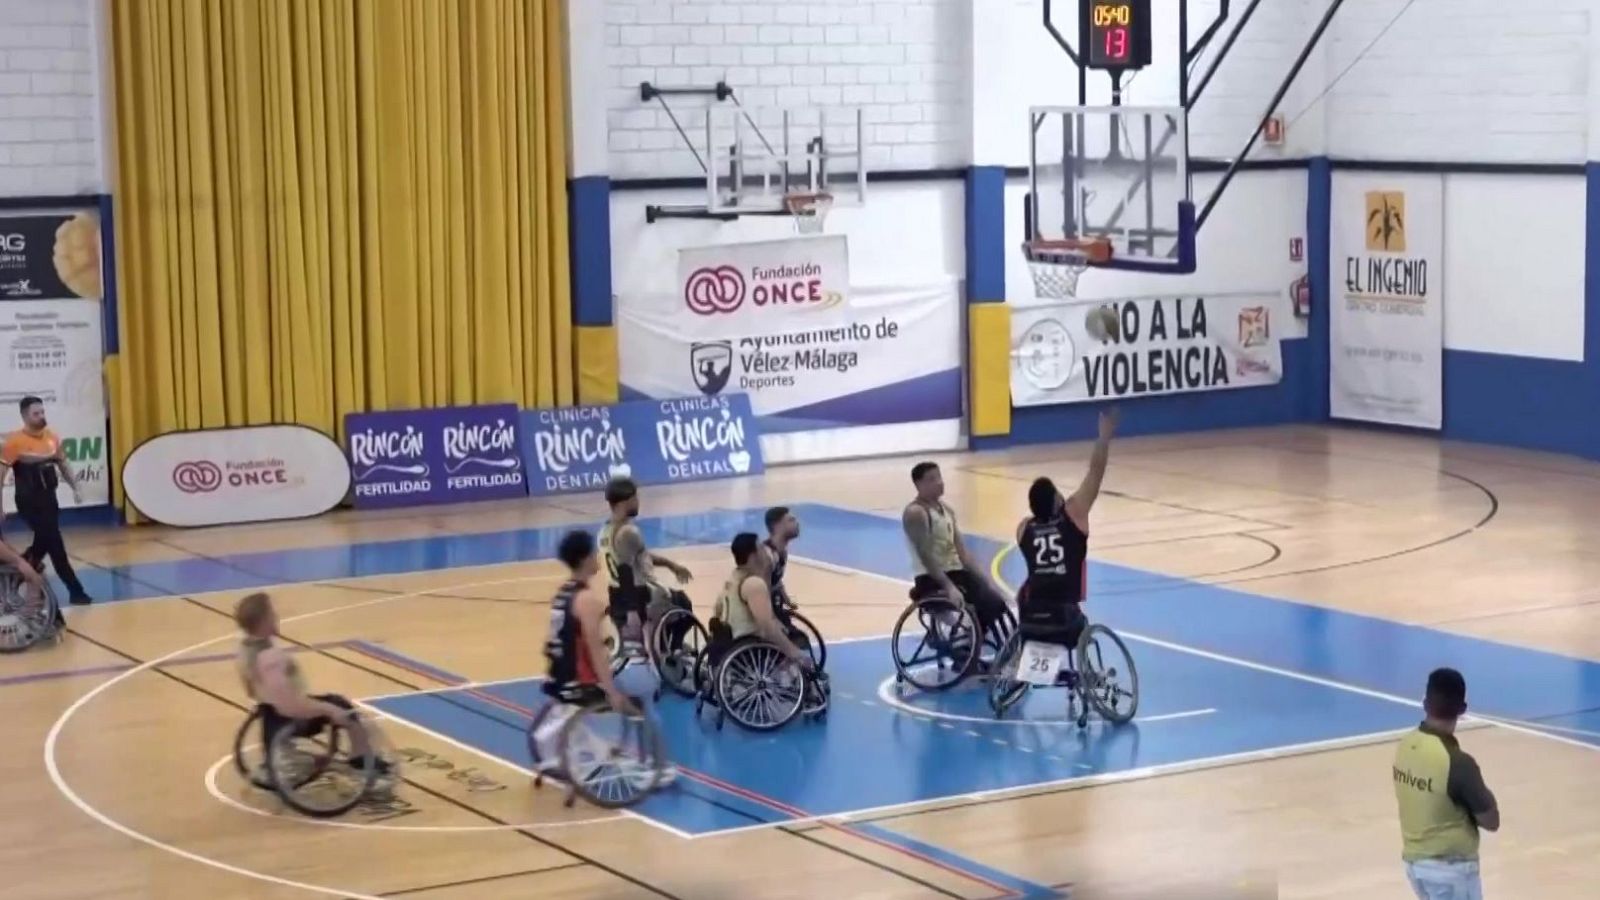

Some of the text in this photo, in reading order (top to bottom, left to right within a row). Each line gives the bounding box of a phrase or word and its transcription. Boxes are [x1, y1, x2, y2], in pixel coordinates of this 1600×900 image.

[1106, 29, 1125, 57] 13
[752, 262, 821, 280] Fundación
[1346, 257, 1427, 297] EL INGENIO
[753, 280, 821, 307] ONCE
[875, 316, 898, 339] de
[1149, 299, 1167, 341] A
[1176, 298, 1207, 340] LA
[1082, 345, 1230, 397] VIOLENCIA
[740, 375, 795, 391] Deportes
[228, 469, 287, 487] ONCE
[448, 472, 522, 489] FERTILIDAD
[668, 460, 732, 478] DENTAL
[356, 480, 431, 496] FERTILIDAD
[1033, 534, 1064, 565] 25
